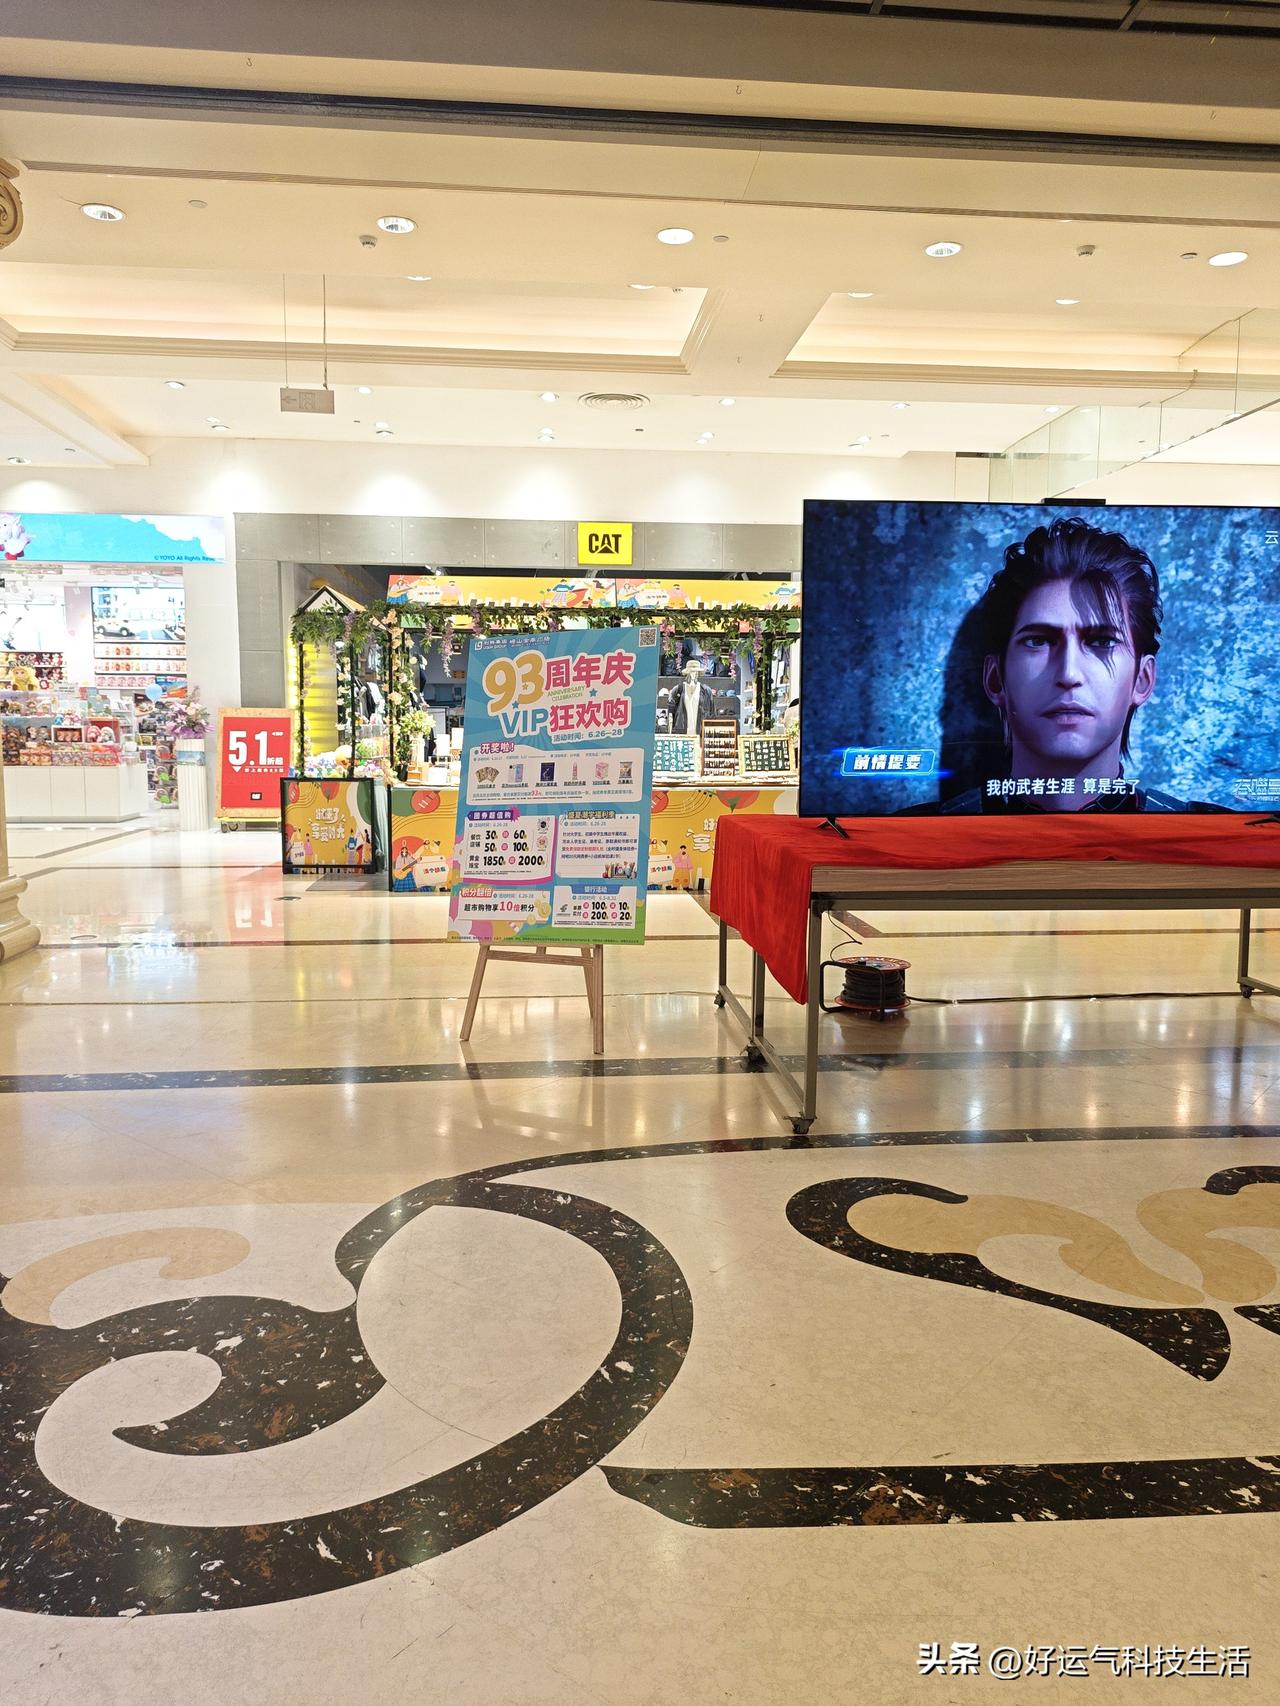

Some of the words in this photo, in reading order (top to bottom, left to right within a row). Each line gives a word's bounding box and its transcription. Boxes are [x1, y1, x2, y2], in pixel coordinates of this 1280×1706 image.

[588, 533, 622, 554] CAT
[1264, 530, 1279, 545] 云
[547, 685, 586, 697] ANNIVERSARY
[551, 692, 583, 702] CELEBRATION
[986, 778, 1075, 796] 我的武者生涯
[1083, 778, 1140, 795] 算是完了
